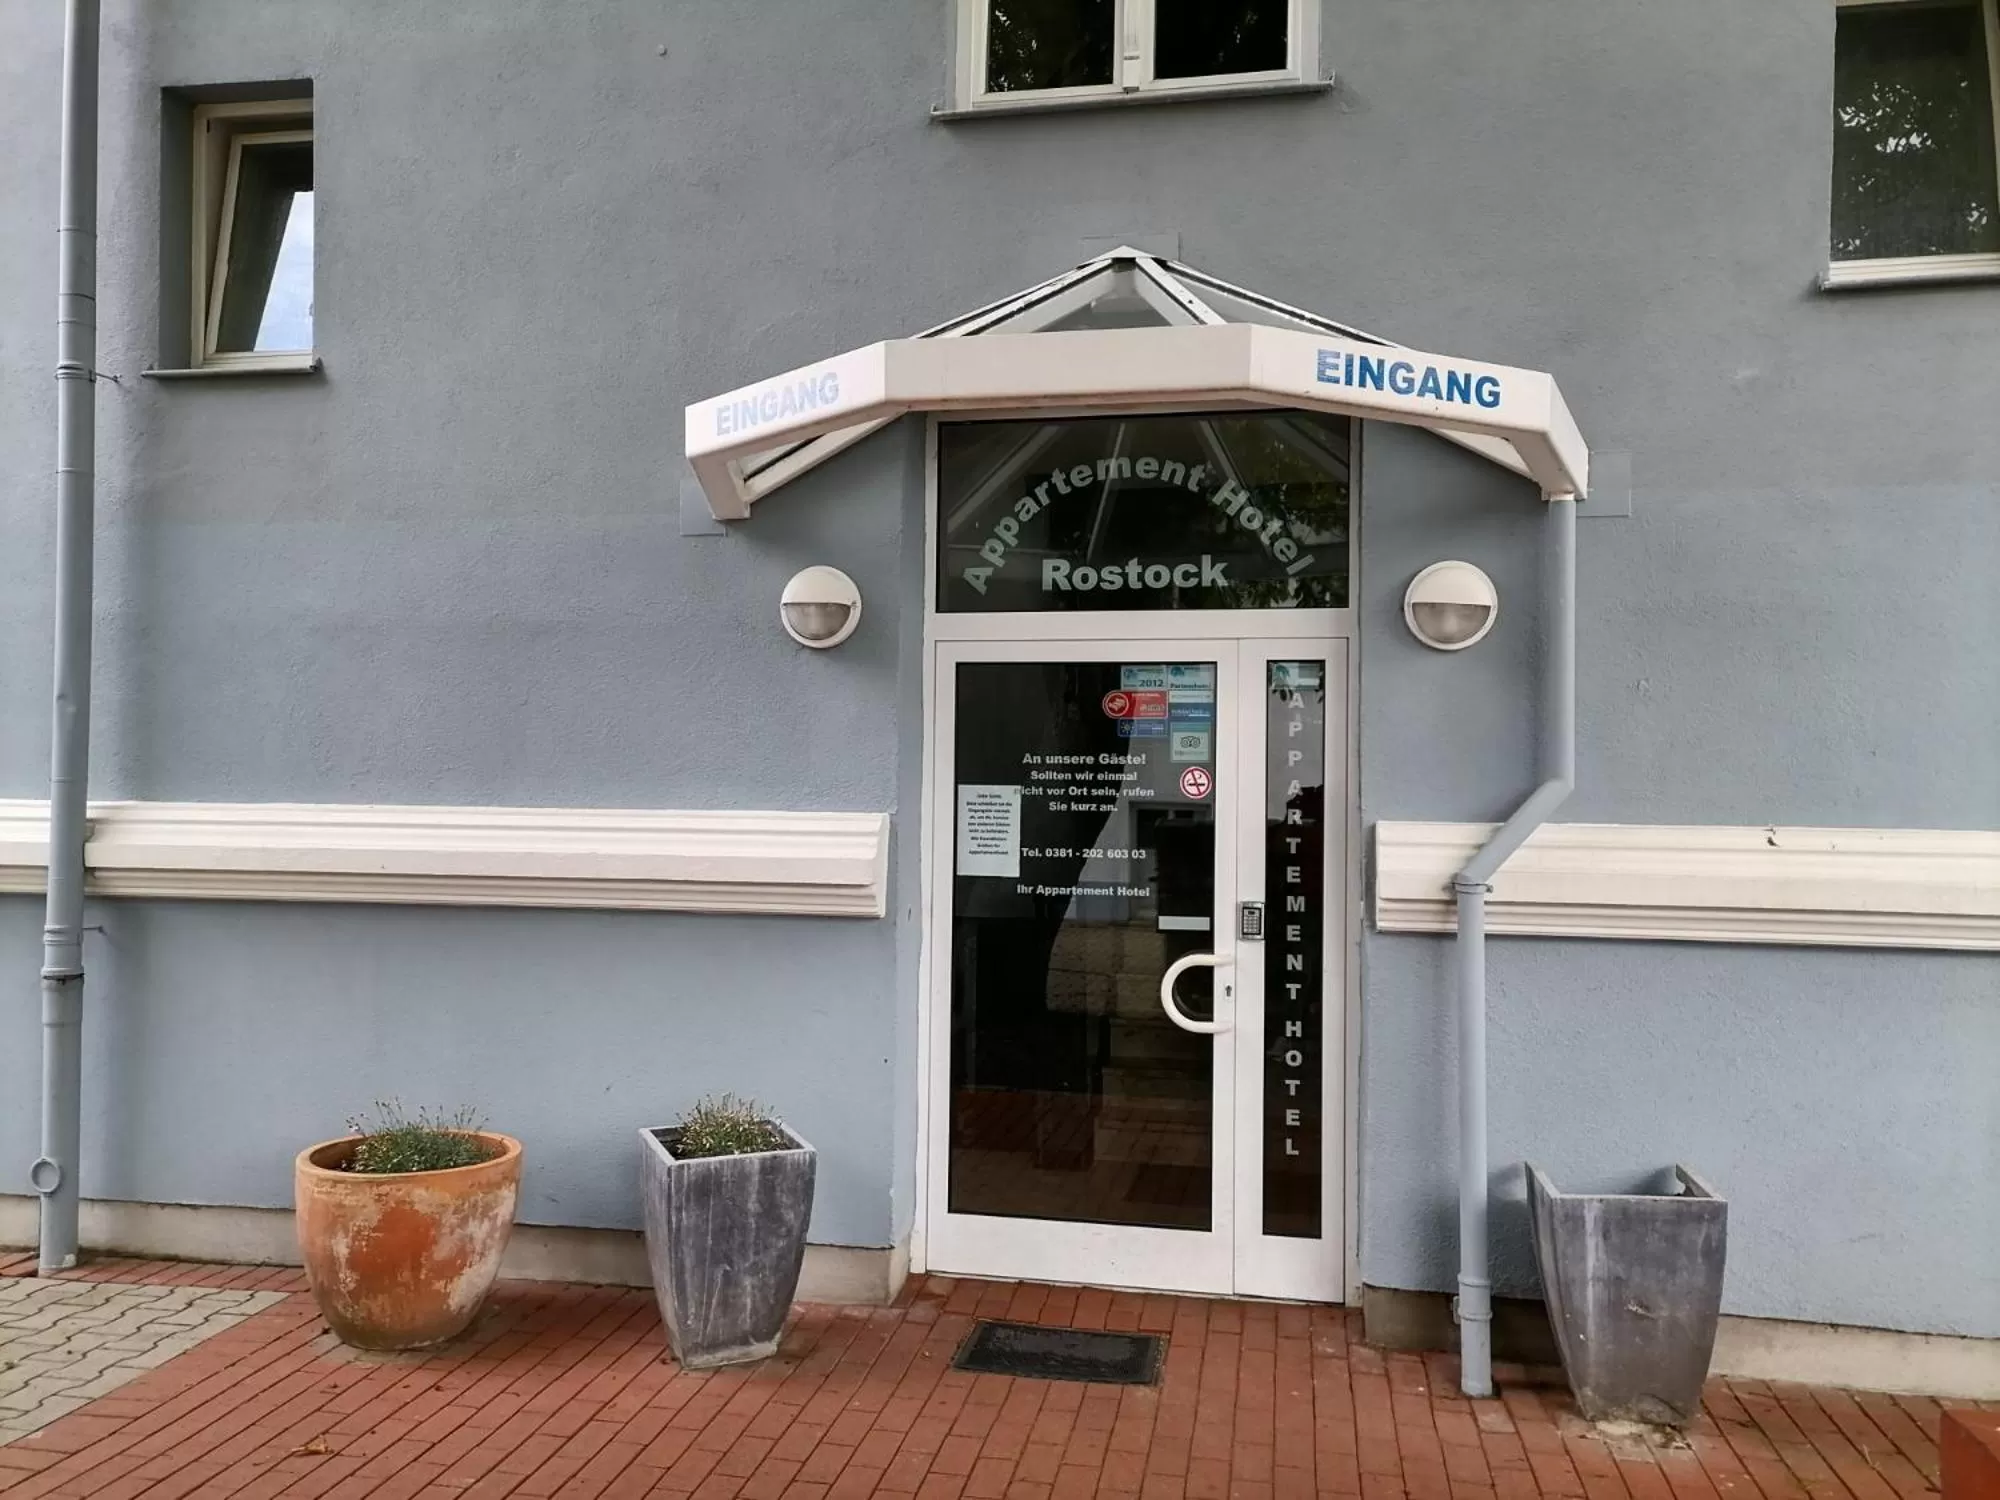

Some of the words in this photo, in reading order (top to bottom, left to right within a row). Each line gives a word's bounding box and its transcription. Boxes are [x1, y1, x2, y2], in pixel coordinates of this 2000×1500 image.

[1317, 349, 1501, 408] EINGANG
[716, 372, 839, 436] EINGANG
[962, 456, 1206, 595] Appartement
[1211, 477, 1315, 575] Hotel
[1042, 554, 1229, 591] Rostock
[1138, 679, 1164, 687] 2012
[1022, 753, 1041, 764] An
[1045, 755, 1094, 764] unsere
[1099, 753, 1146, 764] Gäste!
[1031, 770, 1072, 780] Sollten
[1075, 771, 1094, 780] wir
[1097, 771, 1137, 780] einmal
[1068, 786, 1088, 795] Ort
[1091, 786, 1120, 797] sein,
[1123, 786, 1154, 796] rufen
[1048, 801, 1067, 811] Sie
[1070, 801, 1097, 811] kurz
[1100, 803, 1118, 811] an.
[1285, 692, 1305, 1000] APPARTEMENT
[1021, 847, 1042, 857] Tel.
[1045, 848, 1072, 857] 0381
[1082, 848, 1103, 858] 202
[1107, 848, 1128, 858] 603
[1131, 849, 1146, 858] 03
[1017, 884, 1034, 894] Ihr
[1036, 885, 1114, 896] Appartement
[1117, 886, 1150, 896] Hotel
[1285, 1020, 1302, 1156] HOTEL
